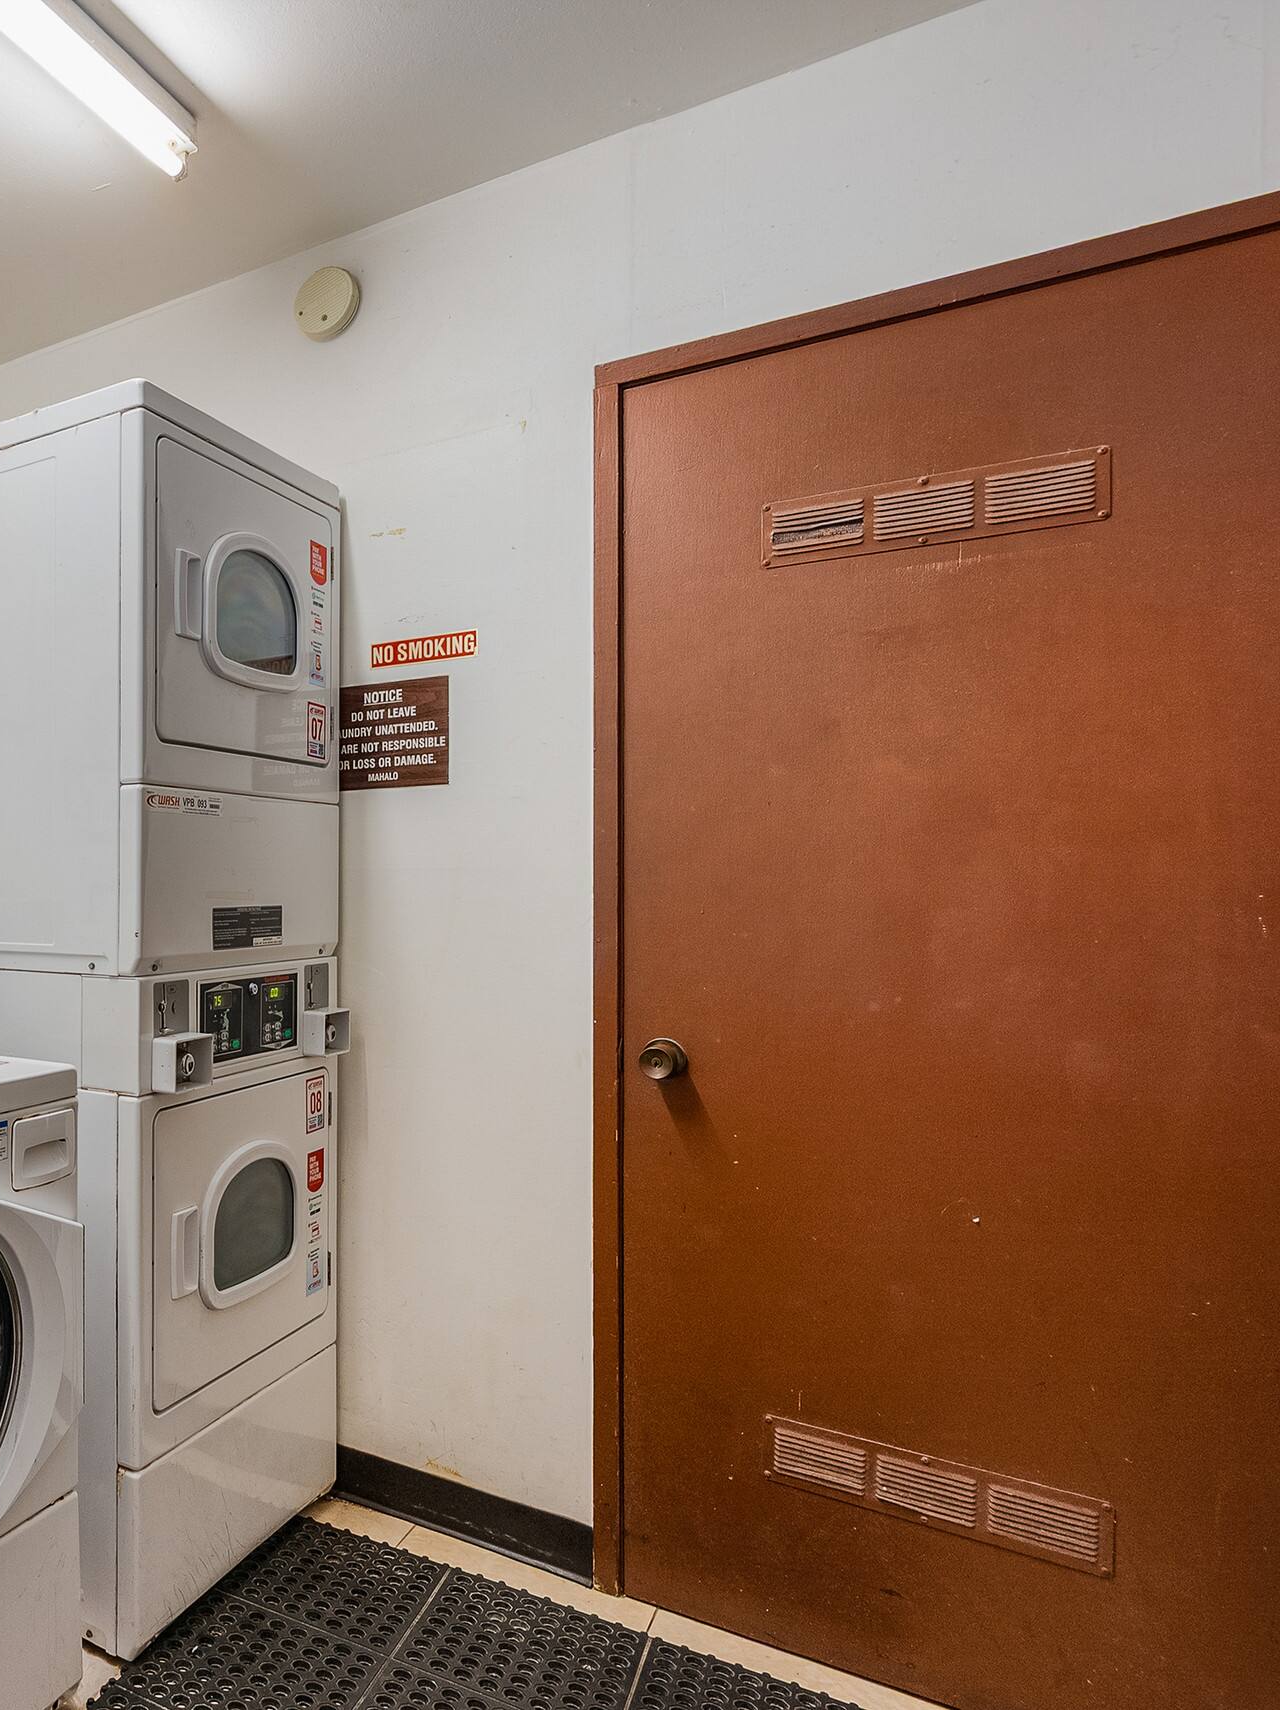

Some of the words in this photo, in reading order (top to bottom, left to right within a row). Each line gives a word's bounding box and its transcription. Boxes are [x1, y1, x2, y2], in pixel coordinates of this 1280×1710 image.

[373, 645, 394, 665] NO
[397, 634, 476, 661] SMOKING
[364, 689, 402, 705] NOTICE
[351, 711, 363, 722] DO
[367, 709, 385, 721] NOT
[387, 706, 416, 719] LEAVE
[311, 717, 323, 741] 07
[340, 727, 372, 740] UNDRY
[375, 720, 439, 736] UNATTENDED.
[341, 744, 358, 754] ARE
[361, 741, 382, 753] NOT
[382, 736, 446, 751] RESPONSIBLE
[353, 758, 376, 770] LOSS
[379, 756, 391, 768] OR
[394, 753, 437, 767] DAMAGE.
[368, 772, 398, 782] MAHALO
[158, 794, 180, 807] WASH
[182, 797, 195, 808] VPB
[310, 1090, 322, 1115] 08
